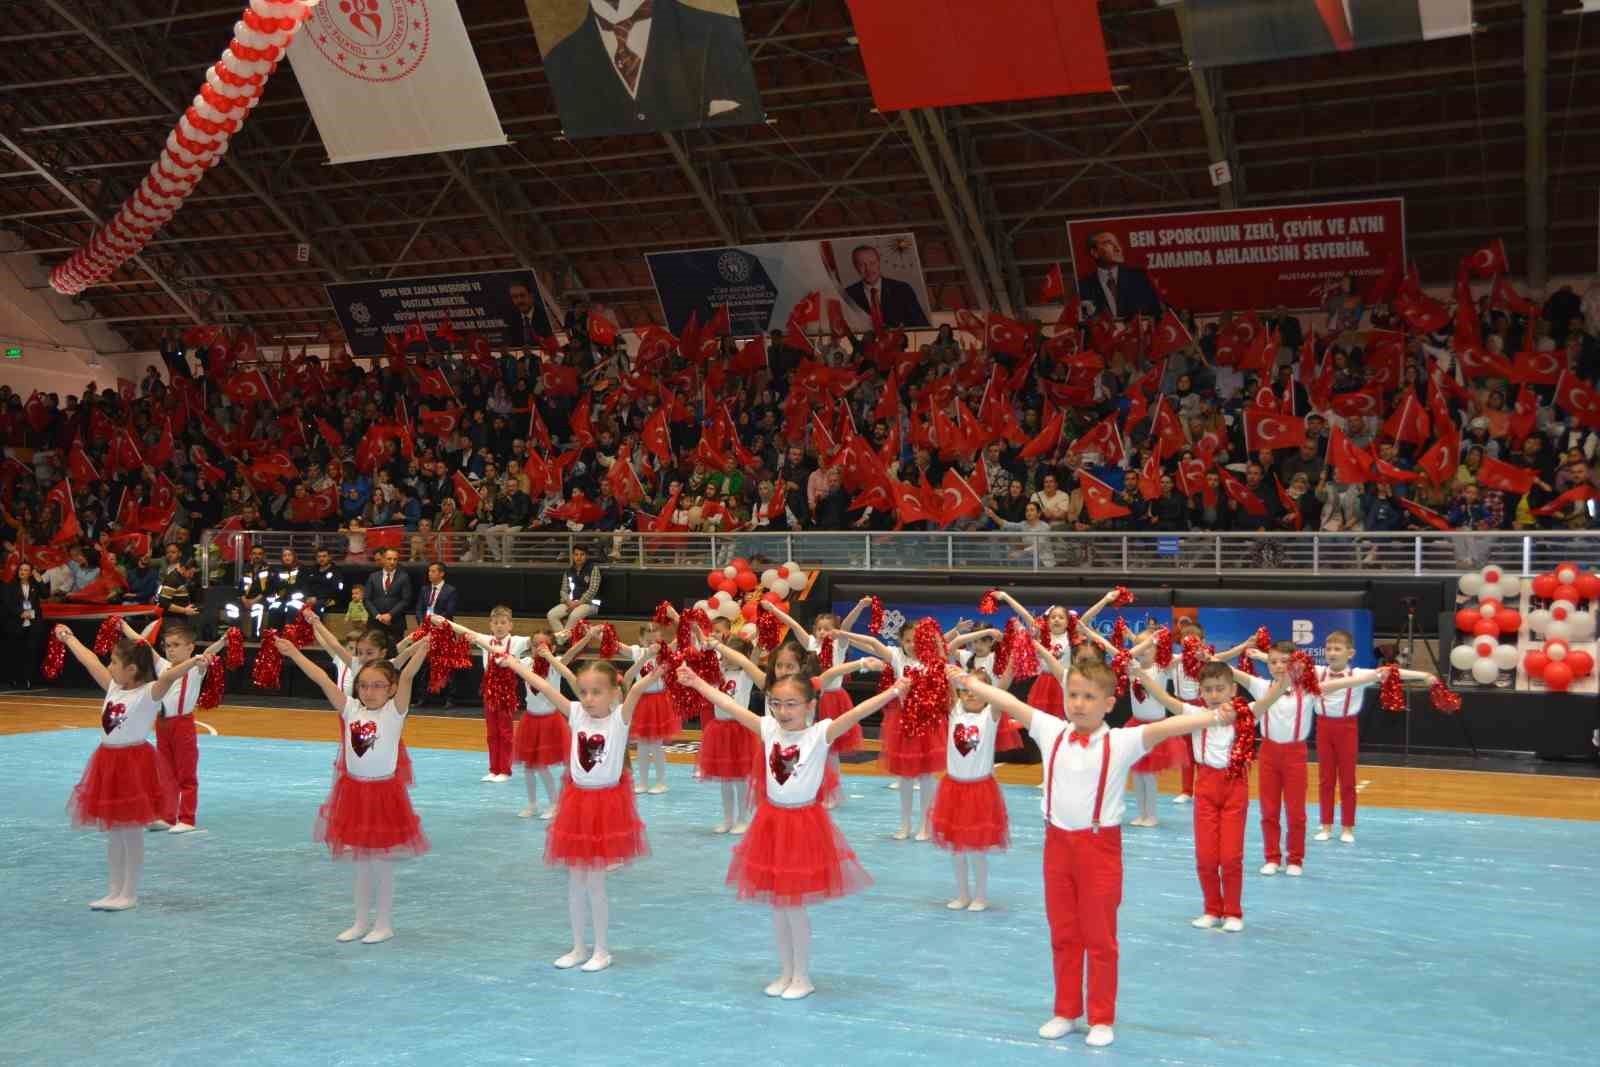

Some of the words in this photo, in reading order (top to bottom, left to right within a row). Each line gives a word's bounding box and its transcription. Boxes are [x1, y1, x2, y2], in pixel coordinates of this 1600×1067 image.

[1215, 167, 1225, 181] F
[1128, 230, 1156, 248] BEN
[1158, 225, 1241, 246] SPORCUNUN
[1242, 218, 1279, 242] ZEKİ,
[1282, 216, 1324, 242] ÇEVİK
[1326, 217, 1345, 236] VE
[1348, 215, 1385, 234] AYNI
[1145, 249, 1213, 270] ZAMANDA
[1215, 244, 1300, 266] AHLAKLISINI
[1303, 238, 1370, 260] SEVERİM.
